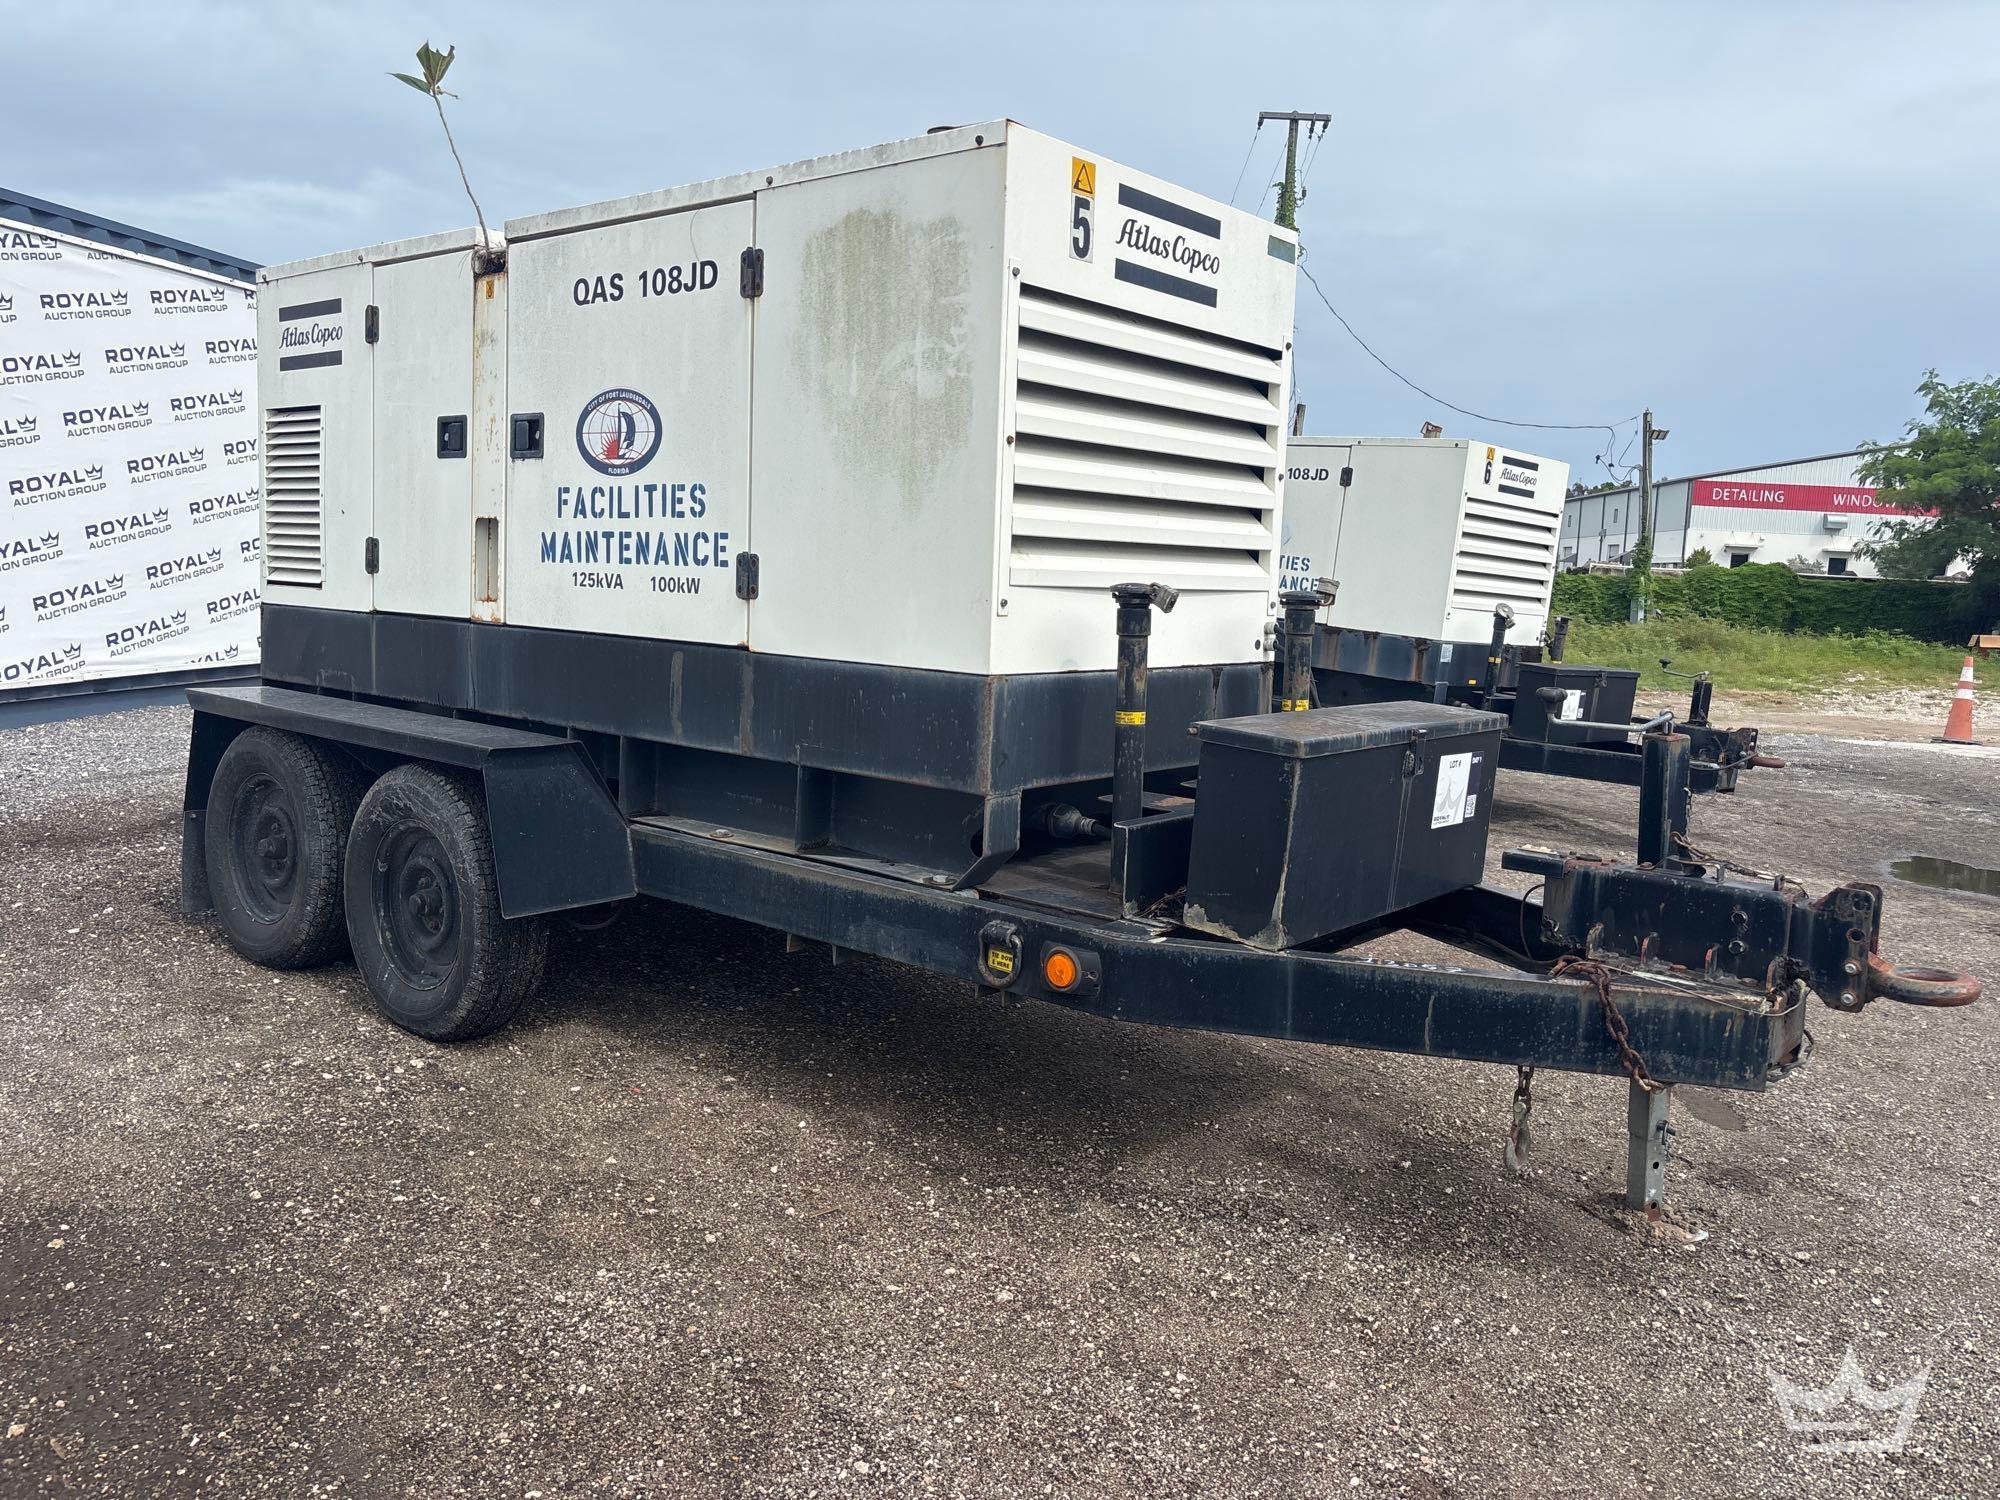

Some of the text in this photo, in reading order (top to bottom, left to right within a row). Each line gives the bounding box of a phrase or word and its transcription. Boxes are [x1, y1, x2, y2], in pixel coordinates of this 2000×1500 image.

[1072, 196, 1091, 259] 5
[0, 234, 40, 249] YAL
[1115, 218, 1220, 274] Atlas Copco
[21, 252, 63, 261] GROUP
[573, 260, 718, 306] QAS 108JD
[40, 293, 112, 309] ROYAL
[150, 289, 212, 304] ROYAL
[44, 309, 132, 321] AUCTION GROUP
[154, 304, 228, 315] AUCTION GROUP
[279, 323, 343, 349] Atlas Copco
[0, 354, 64, 373] OYAL
[105, 345, 171, 363] ROYAL
[208, 355, 249, 365] AUCTION
[0, 370, 85, 386] UCTION GROUP
[109, 360, 188, 375] AUCTION GROUP
[170, 393, 229, 411] ROYAL
[605, 391, 619, 400] FORT
[620, 390, 651, 410] LAUDERDALE
[63, 405, 134, 427] ROYAL
[174, 405, 246, 422] AUCTION GROUP
[67, 419, 153, 438] AUCTION GROUP
[223, 439, 258, 456] ROY
[127, 451, 190, 474] ROYAL
[226, 454, 259, 466] AUCTIO
[9, 470, 86, 495] ROYAL
[131, 463, 208, 485] AUCTION GROUP
[1287, 467, 1329, 481] 108JD
[1484, 461, 1492, 484] 6
[13, 482, 107, 508] AUCTION GROUP
[189, 492, 247, 515] ROYAL
[557, 483, 707, 519] FACILITIES
[1712, 488, 1784, 503] DETAILING
[85, 513, 154, 539] ROYAL
[192, 510, 232, 525] AUCTION
[89, 524, 172, 550] AUCTION GROUP
[0, 538, 41, 559] YAL
[22, 549, 64, 566] GROUP
[541, 530, 729, 568] MAINTENANCE
[146, 553, 208, 580] ROYAL
[150, 563, 224, 590] AUCTION GROUP
[572, 571, 700, 594] 125kVA 100kW
[33, 580, 107, 611] ROYAL
[37, 590, 127, 623] AUCTION GROUP
[210, 606, 248, 624] AUCTION
[106, 617, 172, 648] ROYAL
[110, 626, 190, 659] AUCTION GROUP
[0, 652, 64, 681] OYAL
